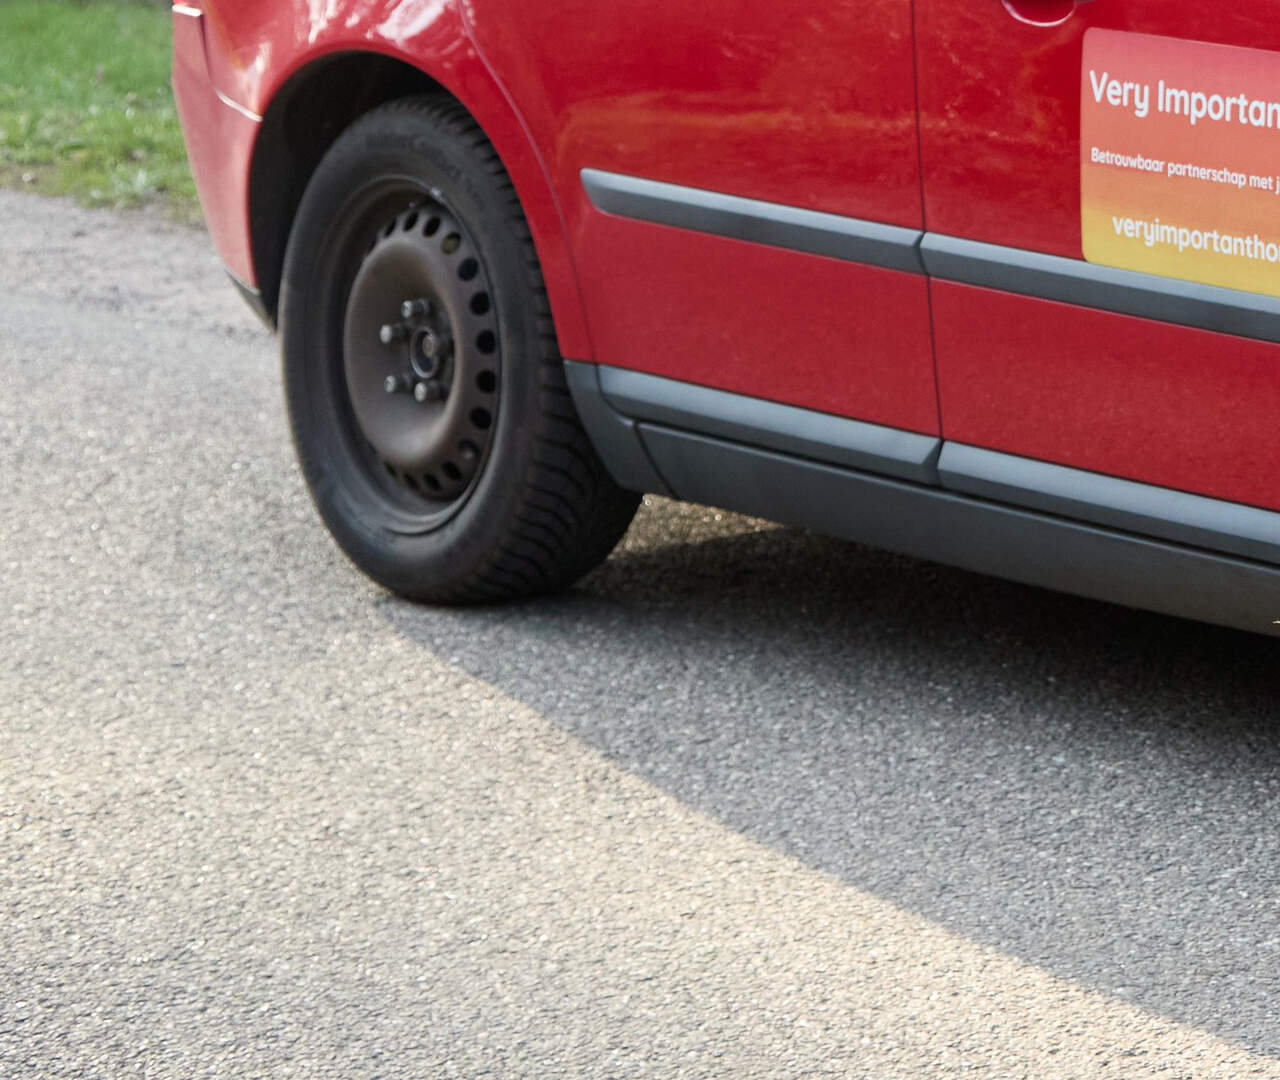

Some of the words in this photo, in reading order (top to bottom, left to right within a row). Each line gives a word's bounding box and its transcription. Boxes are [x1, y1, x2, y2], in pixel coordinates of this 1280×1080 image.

[1089, 69, 1150, 118] Very
[1091, 147, 1165, 173] Betrouwbaar
[1167, 160, 1247, 188] partnerschap
[1249, 174, 1273, 191] met
